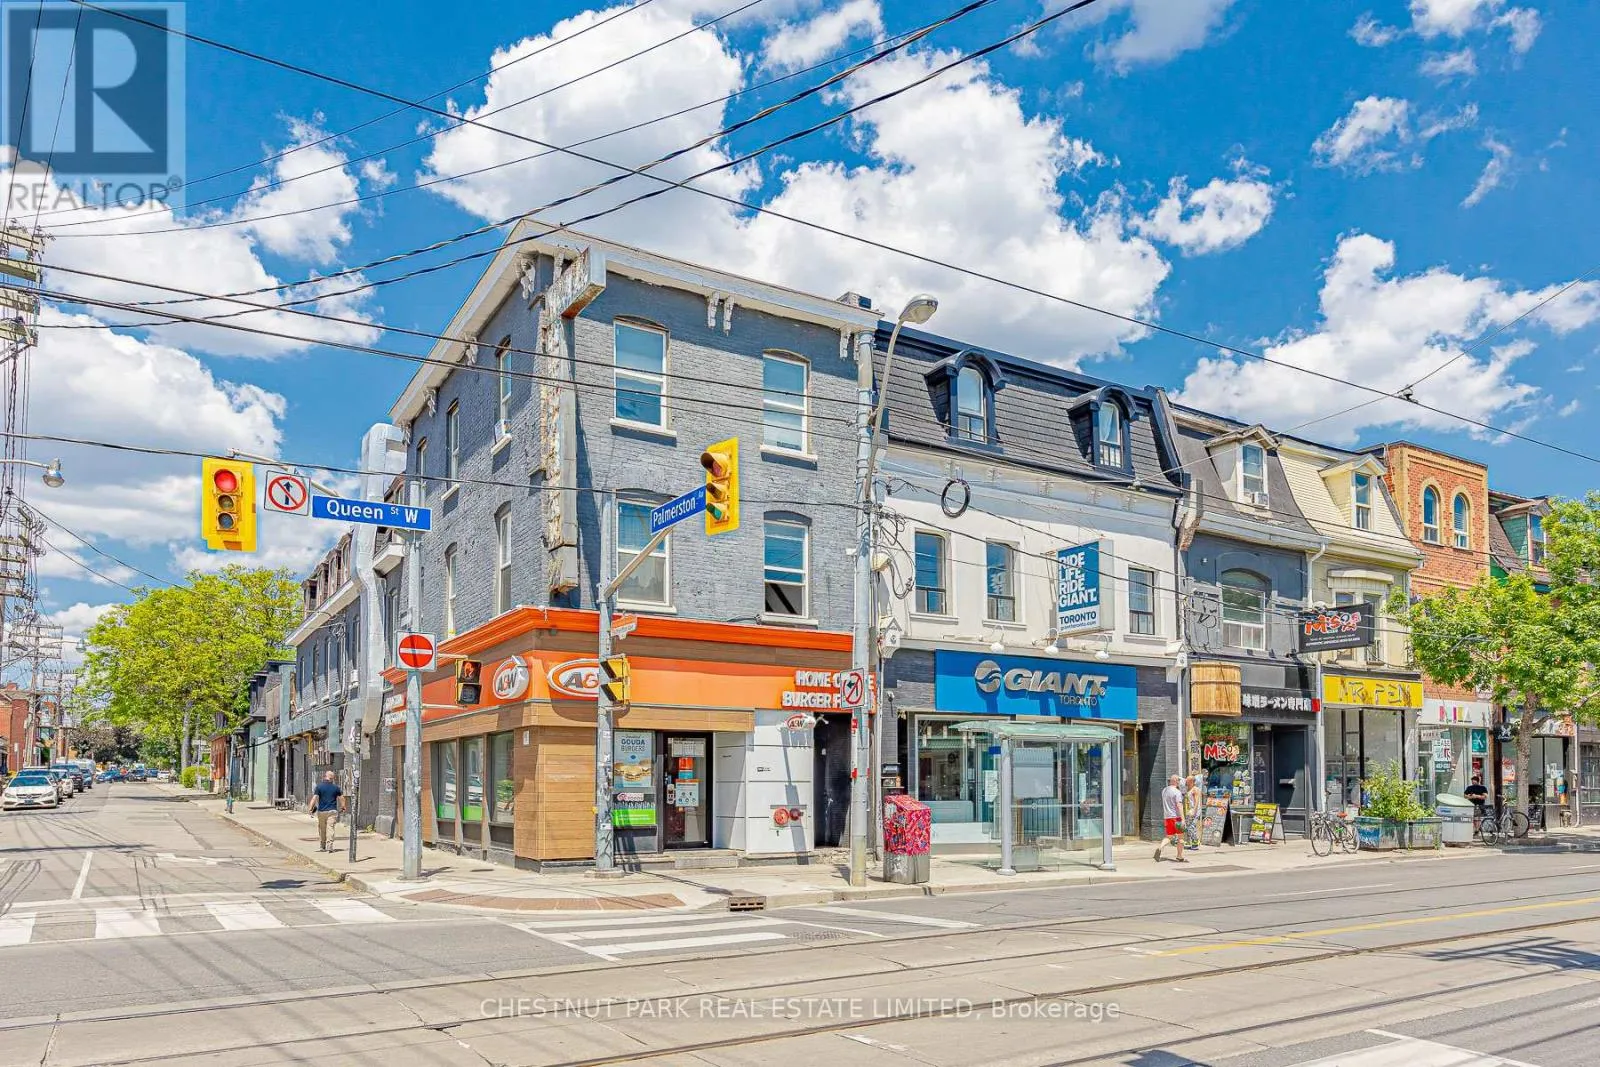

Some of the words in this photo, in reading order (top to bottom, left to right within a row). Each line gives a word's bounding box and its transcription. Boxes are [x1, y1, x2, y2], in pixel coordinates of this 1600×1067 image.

[326, 499, 384, 520] Queen
[390, 506, 400, 516] St
[405, 509, 419, 524] W
[653, 496, 696, 528] Palmerston
[1059, 551, 1085, 569] RIDE
[1059, 578, 1085, 596] RIDE
[1060, 611, 1097, 624] TORONTO
[497, 671, 518, 693] A&W
[563, 672, 599, 689] A&
[796, 670, 832, 687] HOME
[782, 691, 831, 708] BURGER
[1059, 694, 1098, 706] TORONTO
